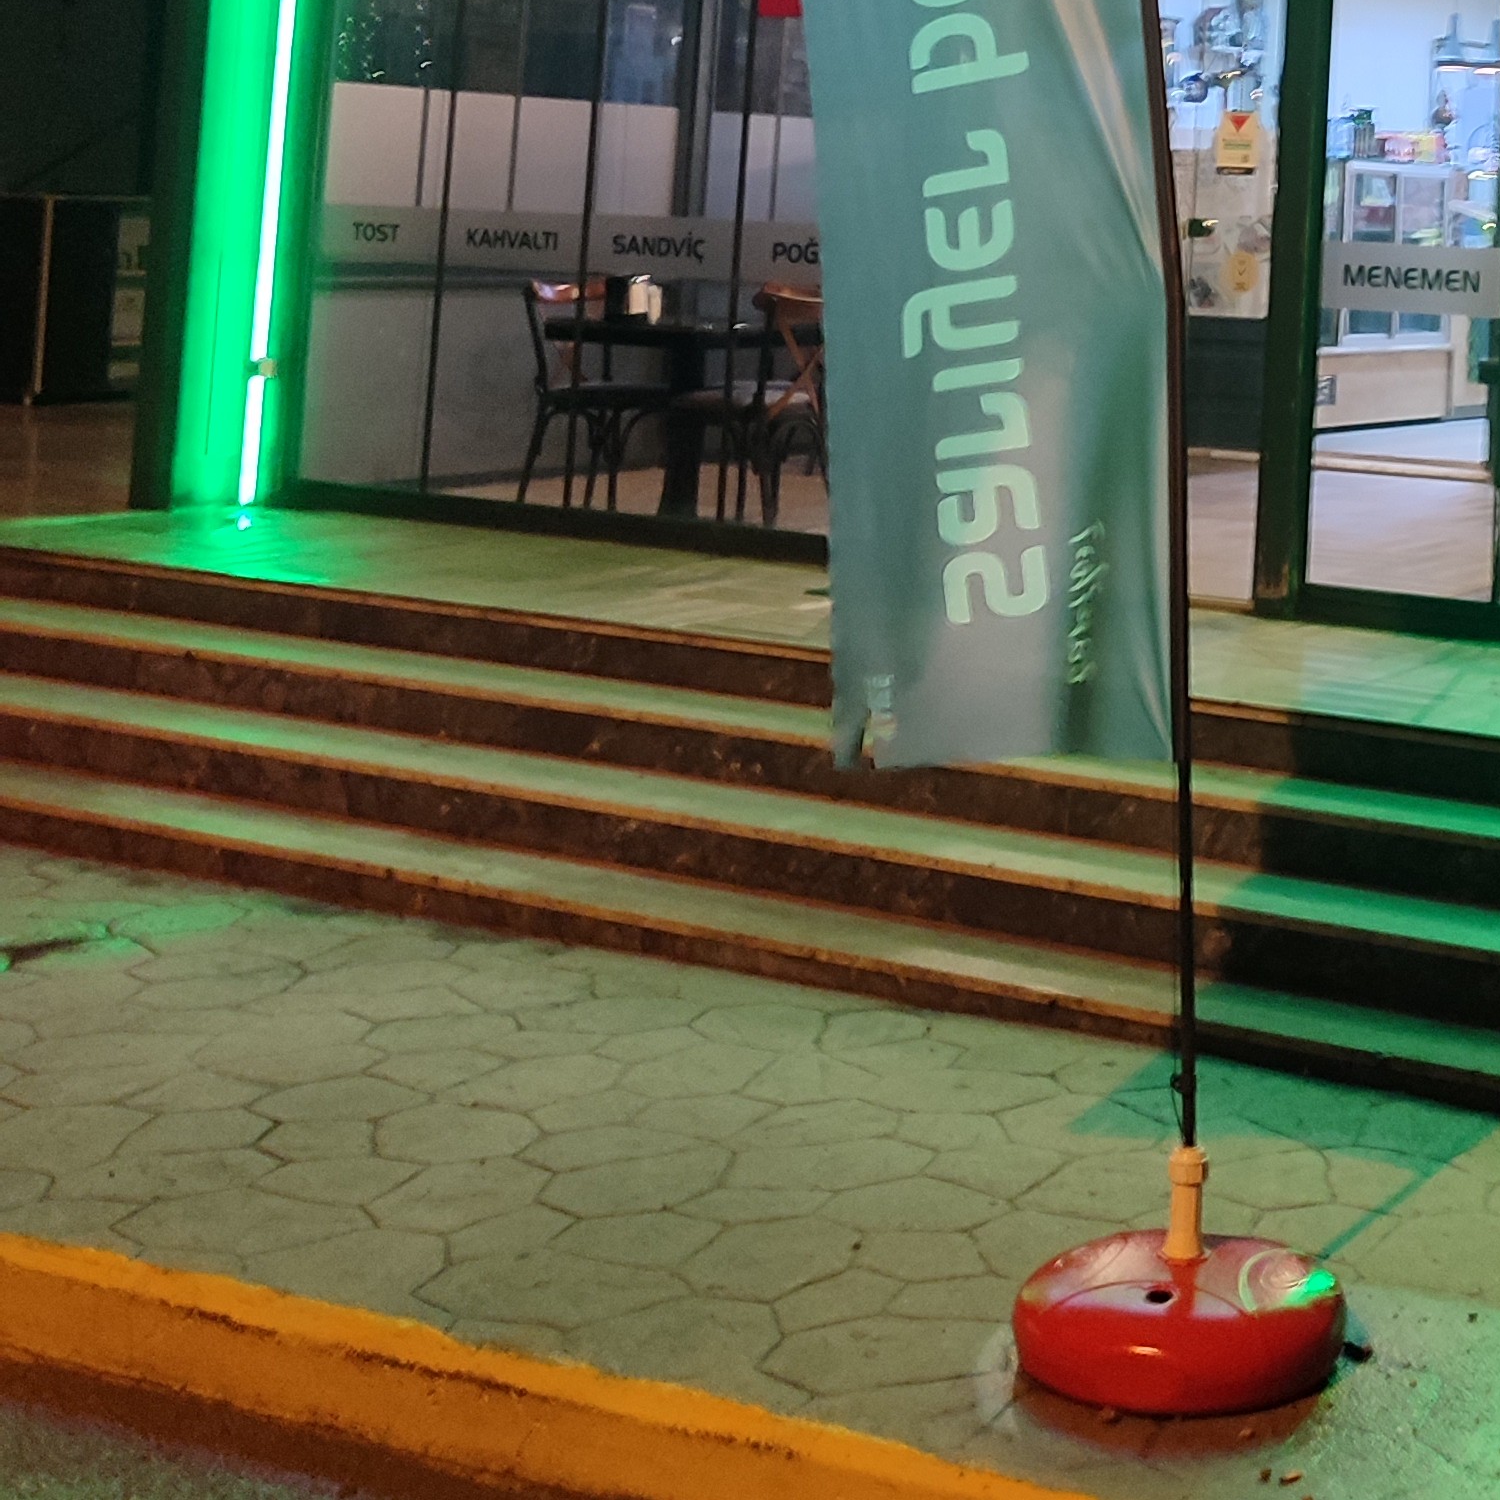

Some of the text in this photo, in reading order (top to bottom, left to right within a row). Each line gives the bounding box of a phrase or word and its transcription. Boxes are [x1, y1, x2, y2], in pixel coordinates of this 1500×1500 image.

[352, 221, 400, 242] TOST
[466, 227, 559, 251] KAHVALTI
[612, 232, 706, 264] SANDVİÇ
[772, 237, 819, 265] POĞ
[1342, 263, 1481, 294] MENEMEN
